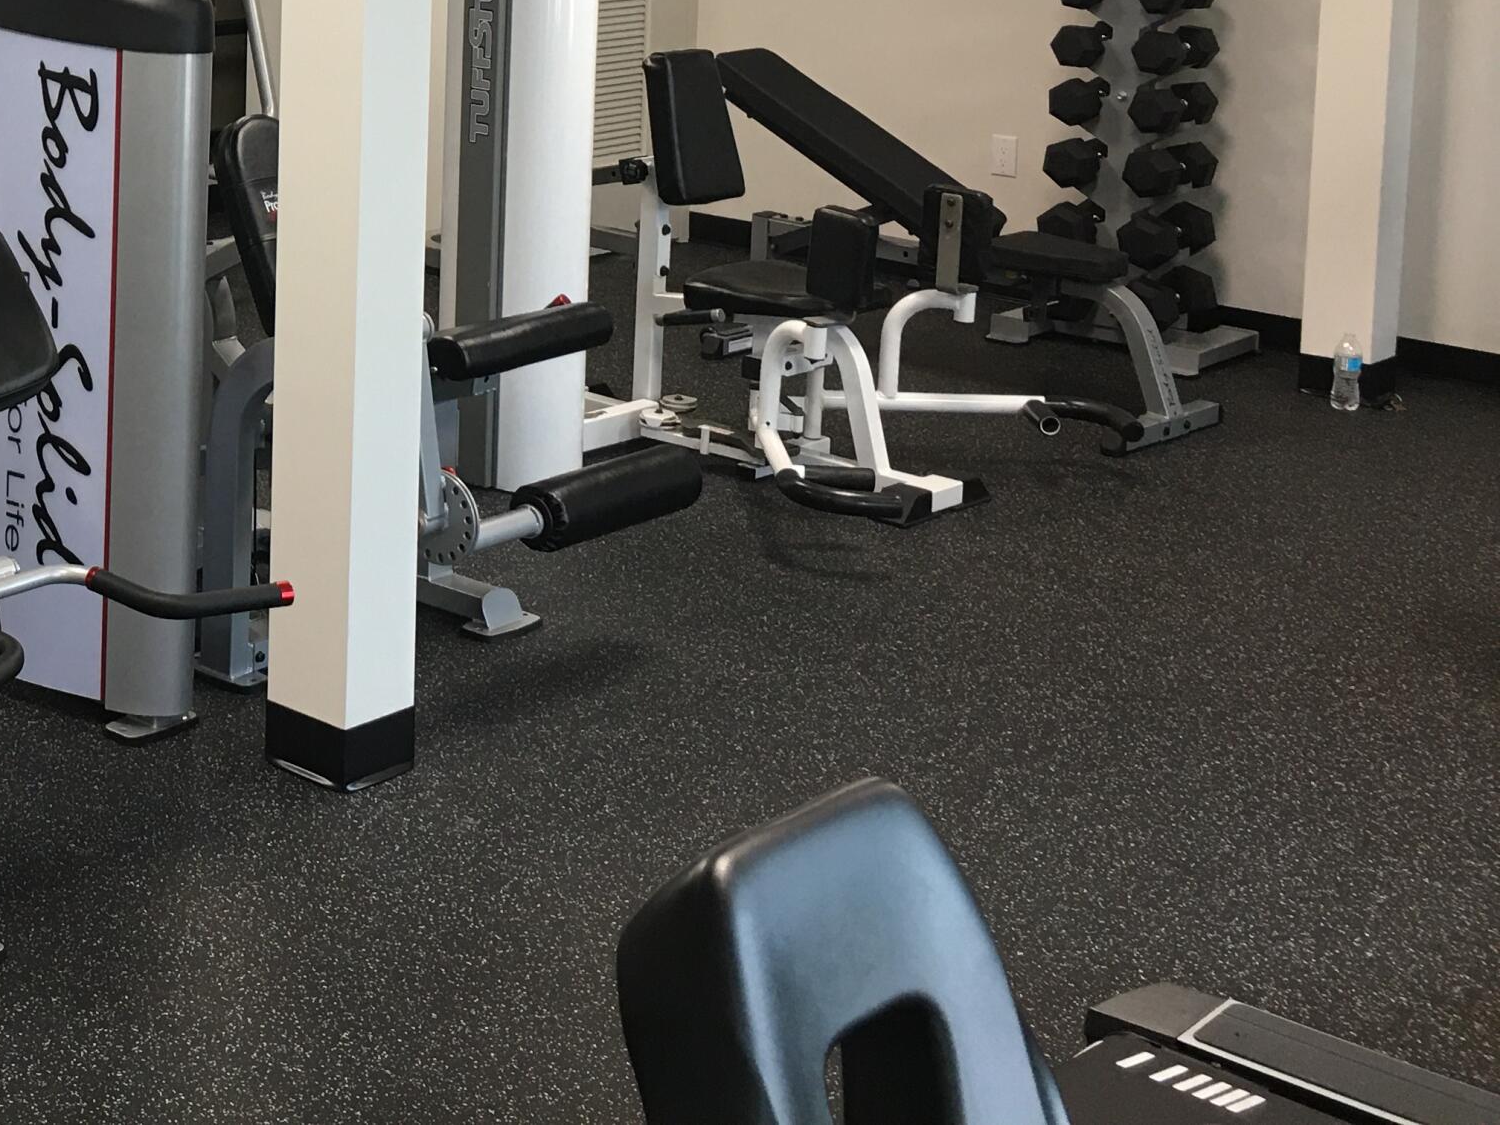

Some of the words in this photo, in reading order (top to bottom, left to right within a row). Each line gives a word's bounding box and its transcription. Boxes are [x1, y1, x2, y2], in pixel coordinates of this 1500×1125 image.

[17, 59, 100, 566] Body-Solid
[7, 401, 27, 454] or
[5, 470, 25, 552] Life
